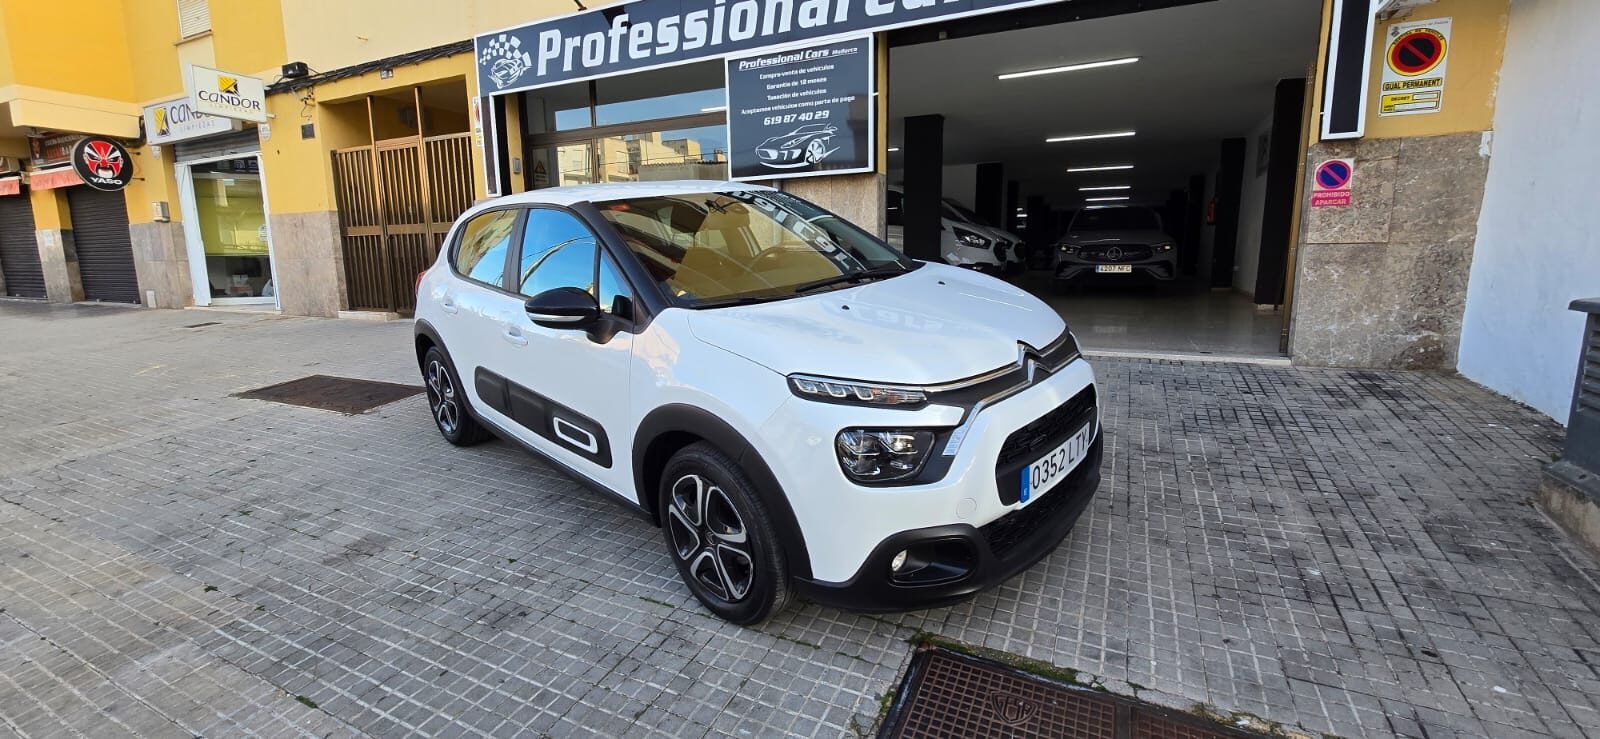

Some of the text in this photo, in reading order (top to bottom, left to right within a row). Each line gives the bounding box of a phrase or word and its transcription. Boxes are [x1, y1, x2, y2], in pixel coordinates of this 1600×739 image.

[739, 51, 803, 70] Professional
[805, 48, 829, 59] Cars
[807, 76, 827, 84] meses
[1385, 78, 1440, 90] GUAL PERMANENT
[741, 106, 771, 116] Aceptamos
[798, 101, 814, 109] como
[814, 98, 831, 107] parte
[839, 95, 855, 103] pago
[763, 110, 830, 126] 619 87 40 29
[1314, 198, 1347, 206] APARCAR
[1032, 428, 1088, 490] 0352 LTY
